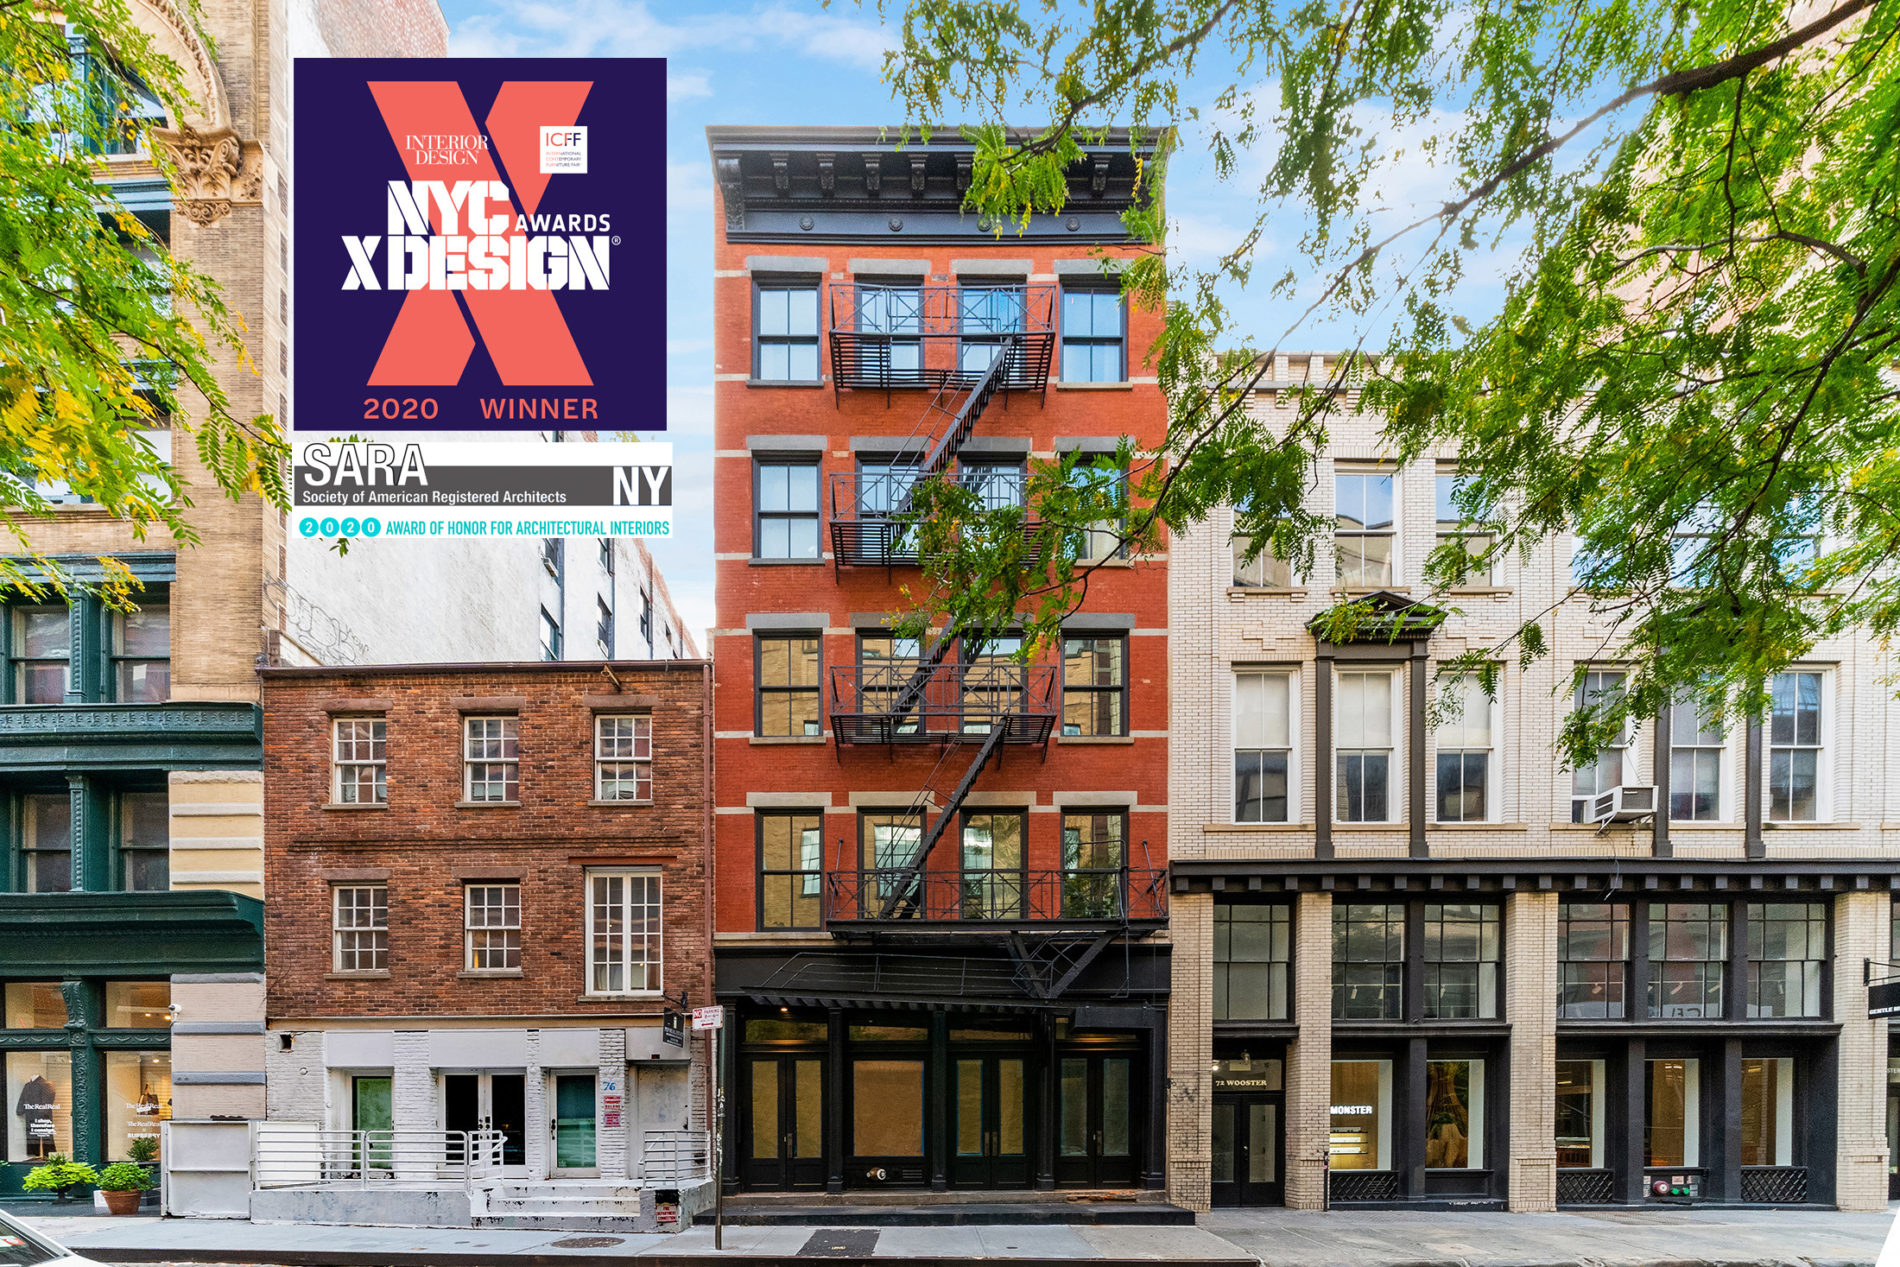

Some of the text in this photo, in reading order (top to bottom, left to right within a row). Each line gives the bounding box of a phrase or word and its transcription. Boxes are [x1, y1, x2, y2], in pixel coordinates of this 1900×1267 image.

[694, 1009, 702, 1019] NO
[602, 1081, 616, 1091] 76
[1330, 1105, 1373, 1115] MONSTER
